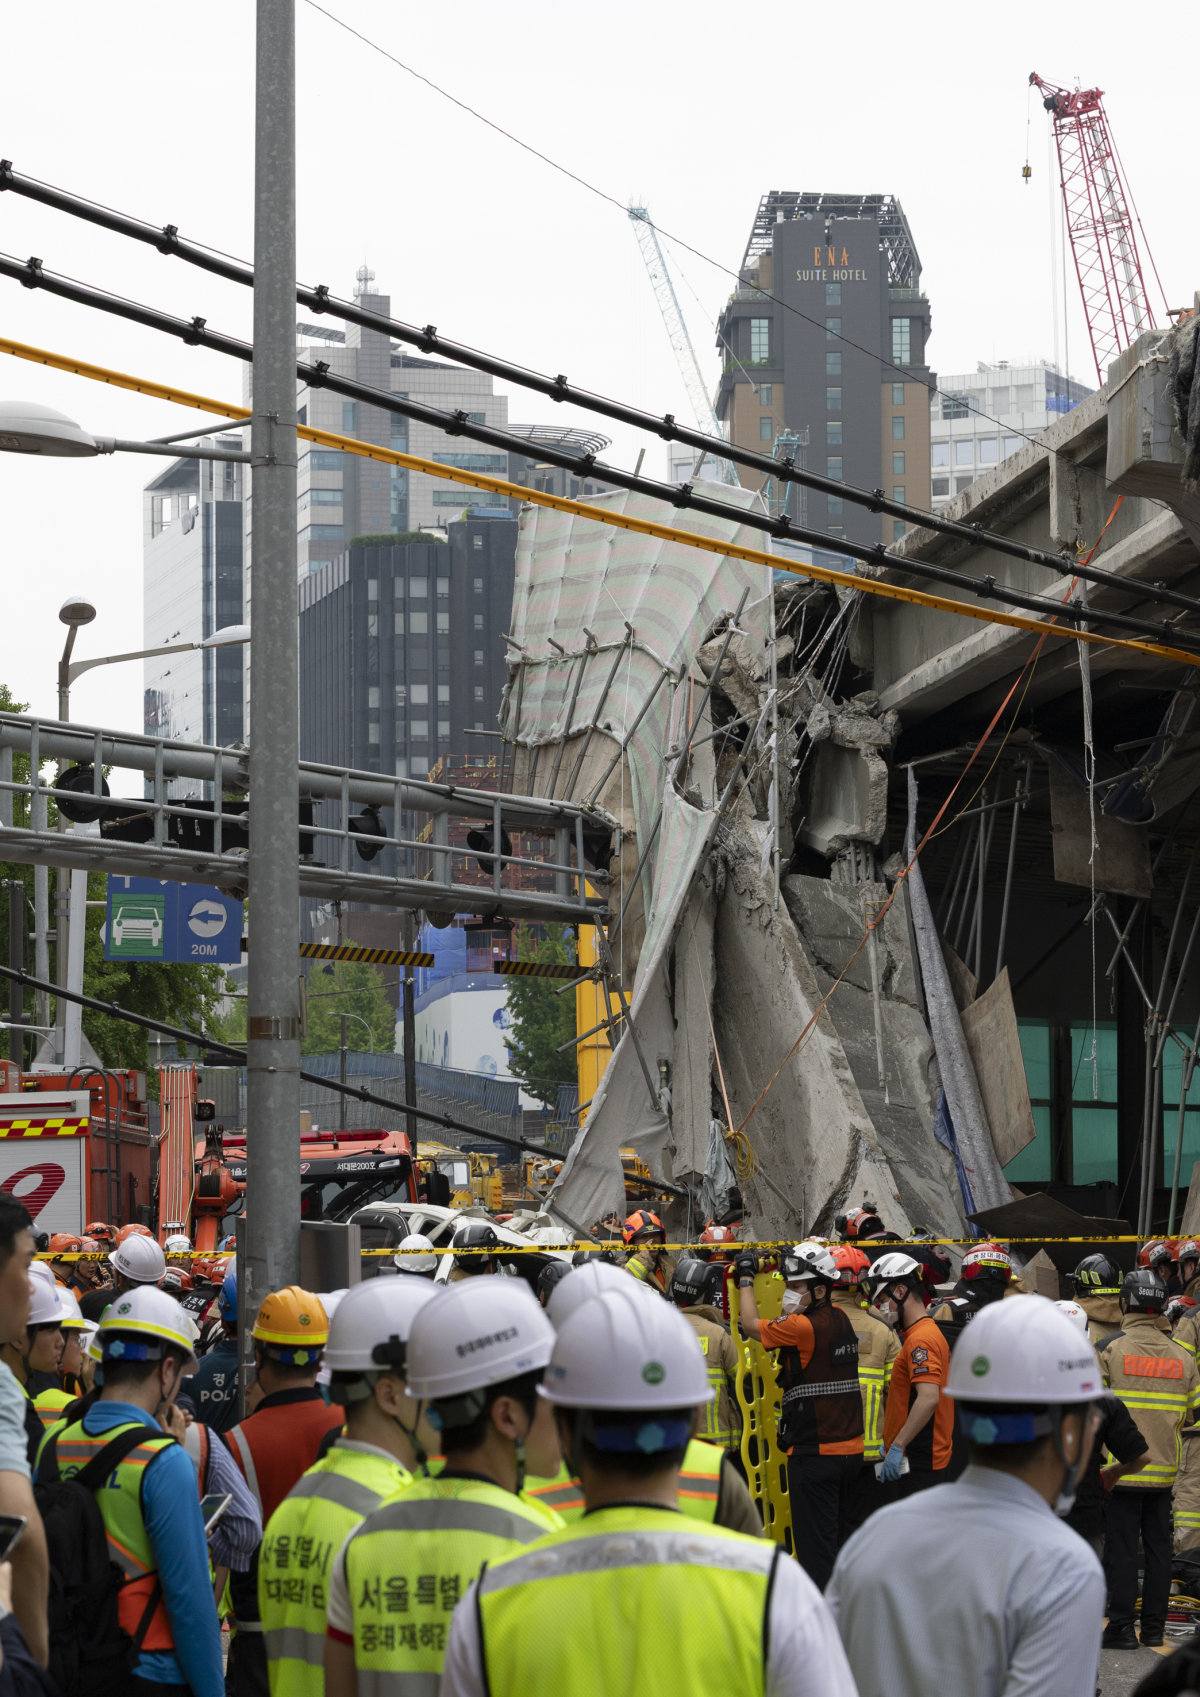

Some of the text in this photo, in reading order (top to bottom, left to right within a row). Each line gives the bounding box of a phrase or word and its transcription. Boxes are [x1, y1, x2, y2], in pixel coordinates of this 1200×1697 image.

[814, 246, 849, 266] ENA
[796, 269, 867, 281] SUITE HOTEL
[191, 944, 217, 955] 20M
[336, 1161, 376, 1171] 서대문200호
[673, 1281, 698, 1295] Seoul fire
[1138, 1286, 1165, 1298] Seoul fire
[358, 1574, 474, 1614] 서울특별
